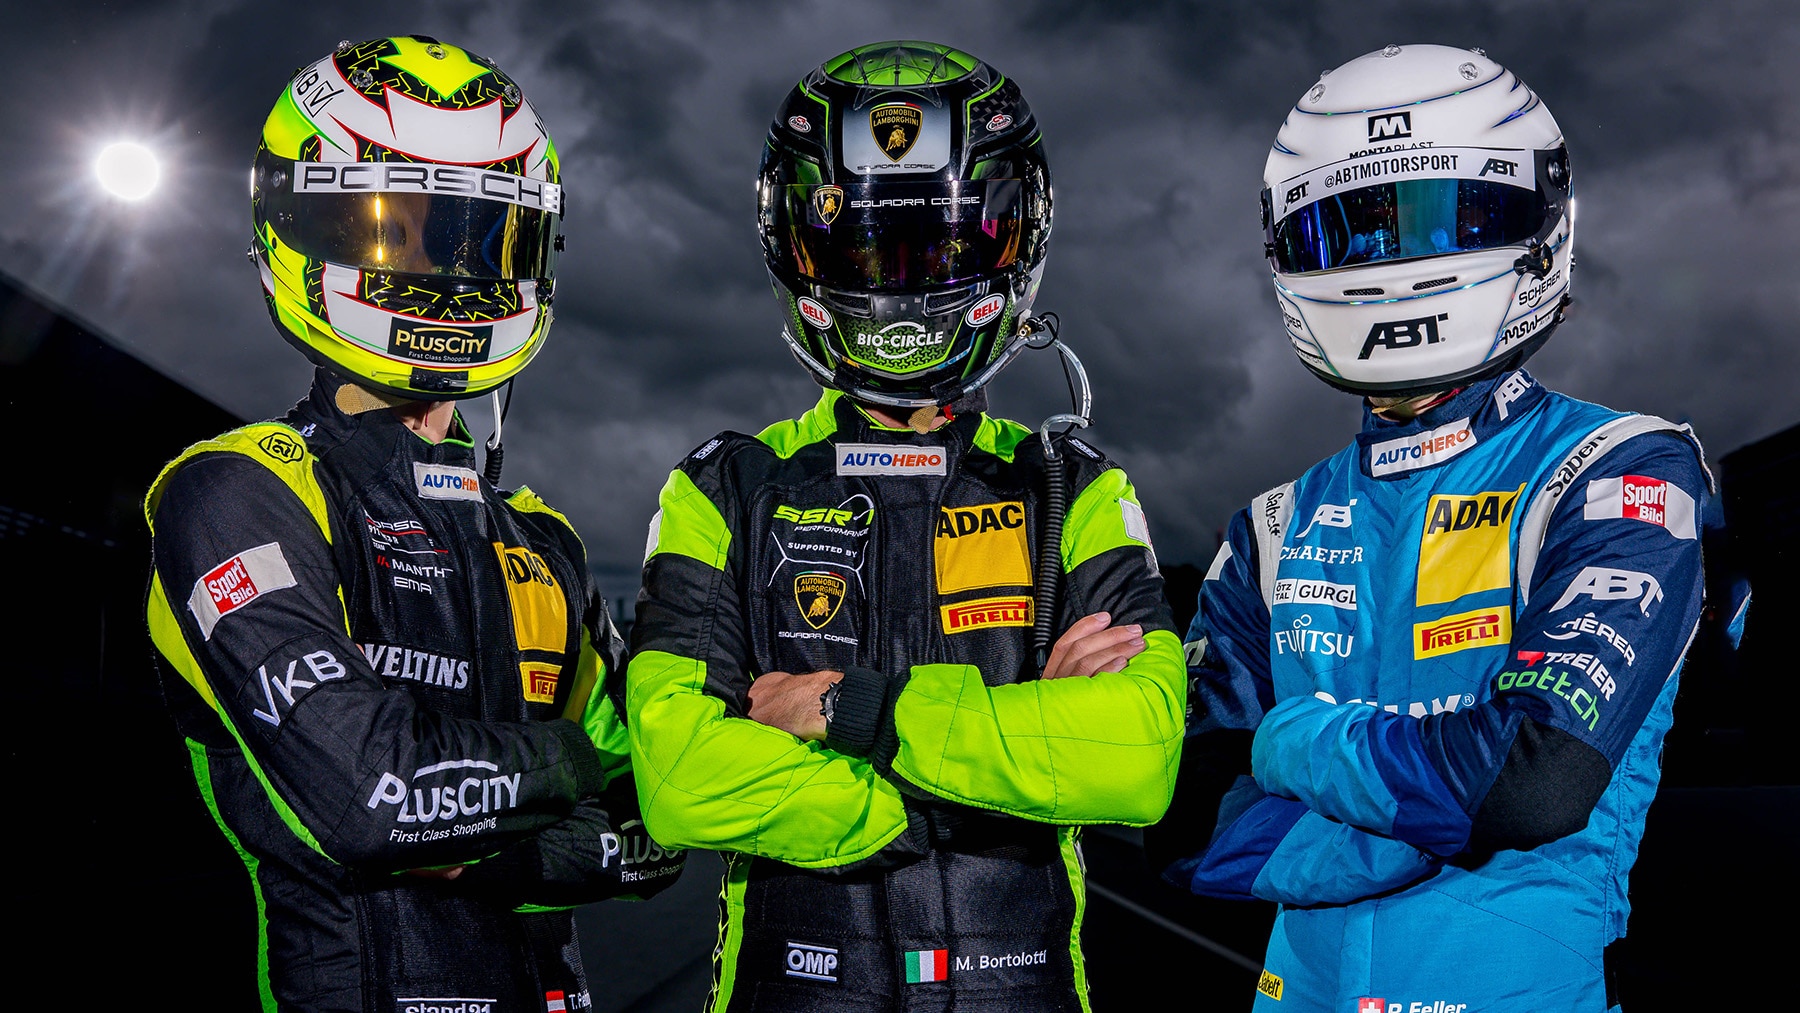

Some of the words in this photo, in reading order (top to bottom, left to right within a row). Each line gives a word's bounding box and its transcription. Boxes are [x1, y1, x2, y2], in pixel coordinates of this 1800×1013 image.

[873, 116, 919, 127] LAMBORGHINI
[875, 108, 917, 118] AUTOMOBILI
[1324, 155, 1459, 188] @ABTMOTORSPORT
[1478, 157, 1519, 178] ABT
[303, 166, 559, 209] PORSCHE
[1283, 180, 1310, 214] ABT
[850, 198, 925, 209] SQUADRA
[931, 196, 981, 206] CORSE
[1518, 269, 1561, 306] SCHERER
[802, 302, 827, 324] BELL
[973, 299, 1000, 321] BELL
[857, 331, 944, 348] BIO-CIRCLE
[1357, 312, 1449, 360] ABT
[408, 351, 424, 359] First
[425, 353, 442, 361] Class
[443, 355, 471, 363] Shopping
[1374, 429, 1470, 467] AUTOHERO
[842, 452, 942, 467] AUTOHERO
[1623, 483, 1667, 507] Sport
[773, 504, 853, 527] SSR
[936, 504, 1024, 539] ADAC
[1295, 499, 1358, 538] AB
[1639, 505, 1664, 524] Bild
[787, 541, 843, 555] SUPPORTED
[845, 549, 858, 559] BY
[1279, 546, 1364, 565] CHAEFFR
[392, 558, 454, 578] MANTH
[506, 552, 554, 588] DAC
[208, 558, 248, 603] Sport
[394, 576, 432, 595] EMA
[797, 585, 843, 597] LAMBORGHINI
[800, 577, 840, 589] AUTOMOBILI
[1276, 582, 1292, 593] ÖTZ
[1549, 566, 1665, 616] ABT
[229, 586, 256, 607] Bild
[1275, 592, 1290, 601] TAL
[1298, 584, 1357, 605] GURGL
[948, 601, 1030, 629] PIRELLI
[778, 631, 822, 640] SQUADRA
[824, 633, 859, 646] CORSE
[1274, 628, 1354, 659] FUJITSU
[1421, 614, 1500, 652] PIRELLI
[364, 643, 470, 690] VELTINS
[1543, 652, 1617, 702] TREIER
[253, 650, 346, 727] VKB
[389, 828, 420, 844] First
[421, 828, 451, 843] Class
[452, 816, 498, 837] Shopping
[600, 832, 680, 868] PLUS
[621, 870, 638, 883] First
[638, 869, 658, 881] Class
[787, 949, 838, 976] OMP
[955, 955, 974, 971] M.
[979, 950, 1047, 970] Bortolotti
